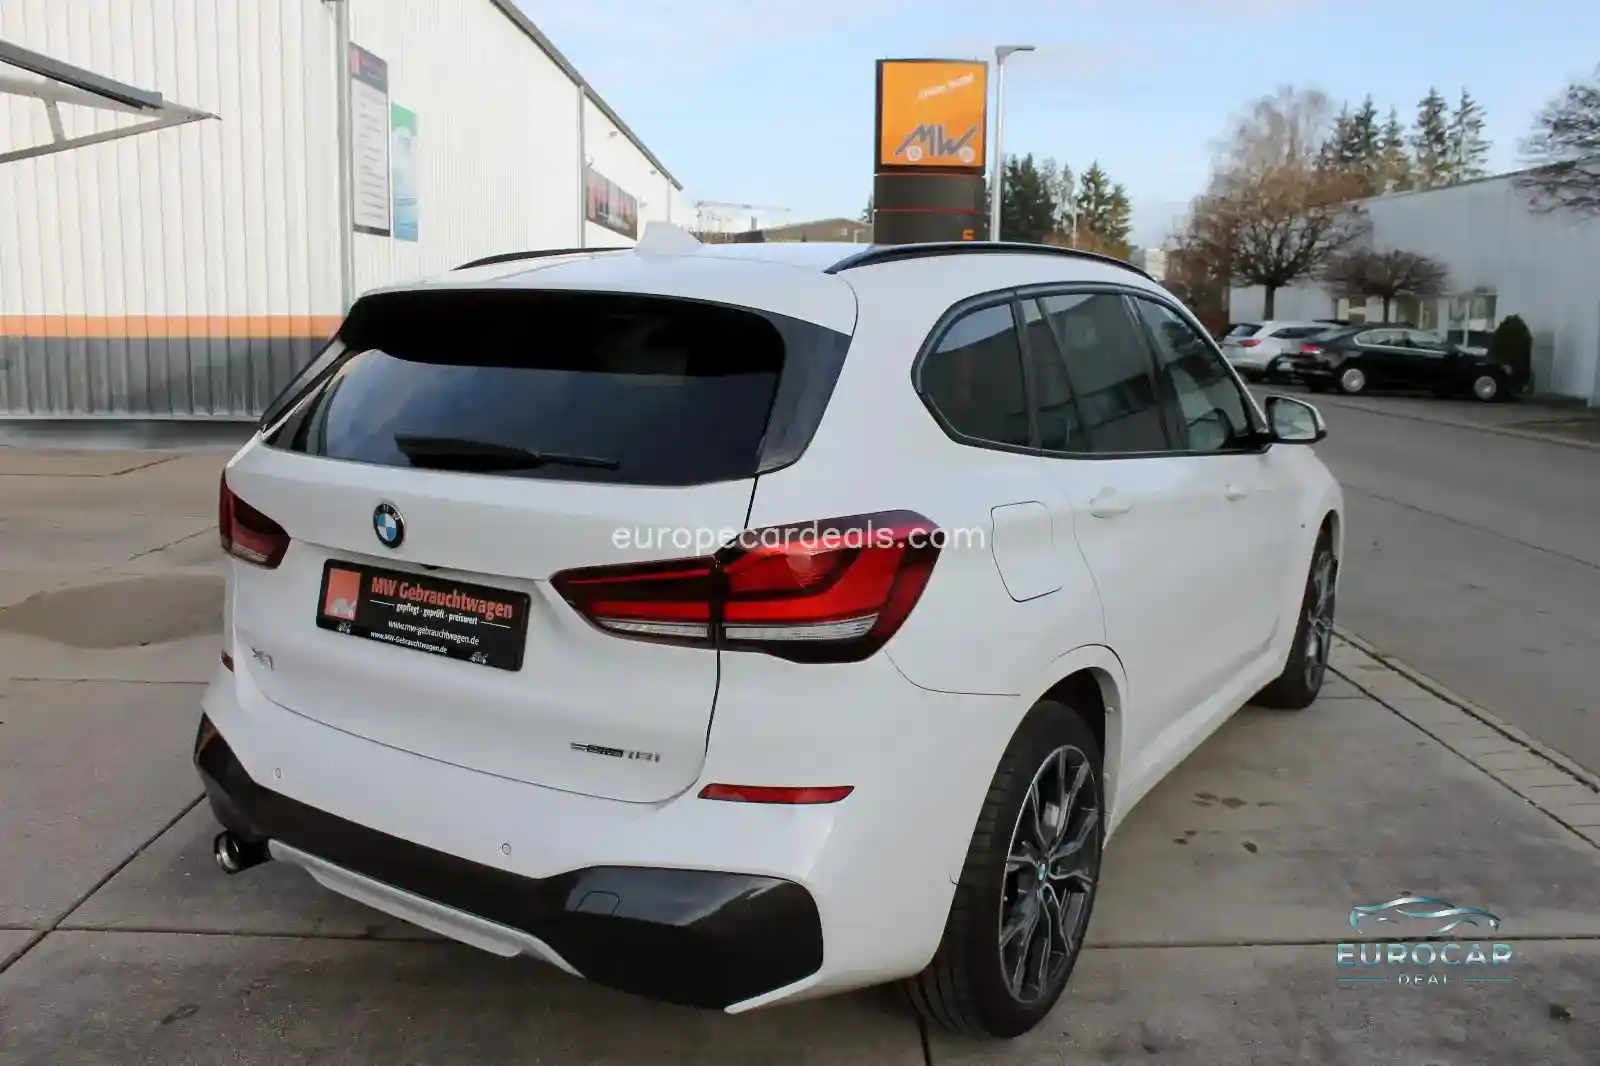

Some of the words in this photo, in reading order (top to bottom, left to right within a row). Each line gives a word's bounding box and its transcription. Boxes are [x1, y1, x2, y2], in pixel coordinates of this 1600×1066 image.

[895, 124, 977, 157] MW
[371, 576, 397, 597] MW
[399, 582, 514, 620] Gebrauchtwagen
[395, 602, 420, 616] gepflegt
[423, 607, 446, 618] geprüft
[448, 612, 479, 626] preiswert
[388, 620, 480, 646] www.mw-gebrauchtwagen.de
